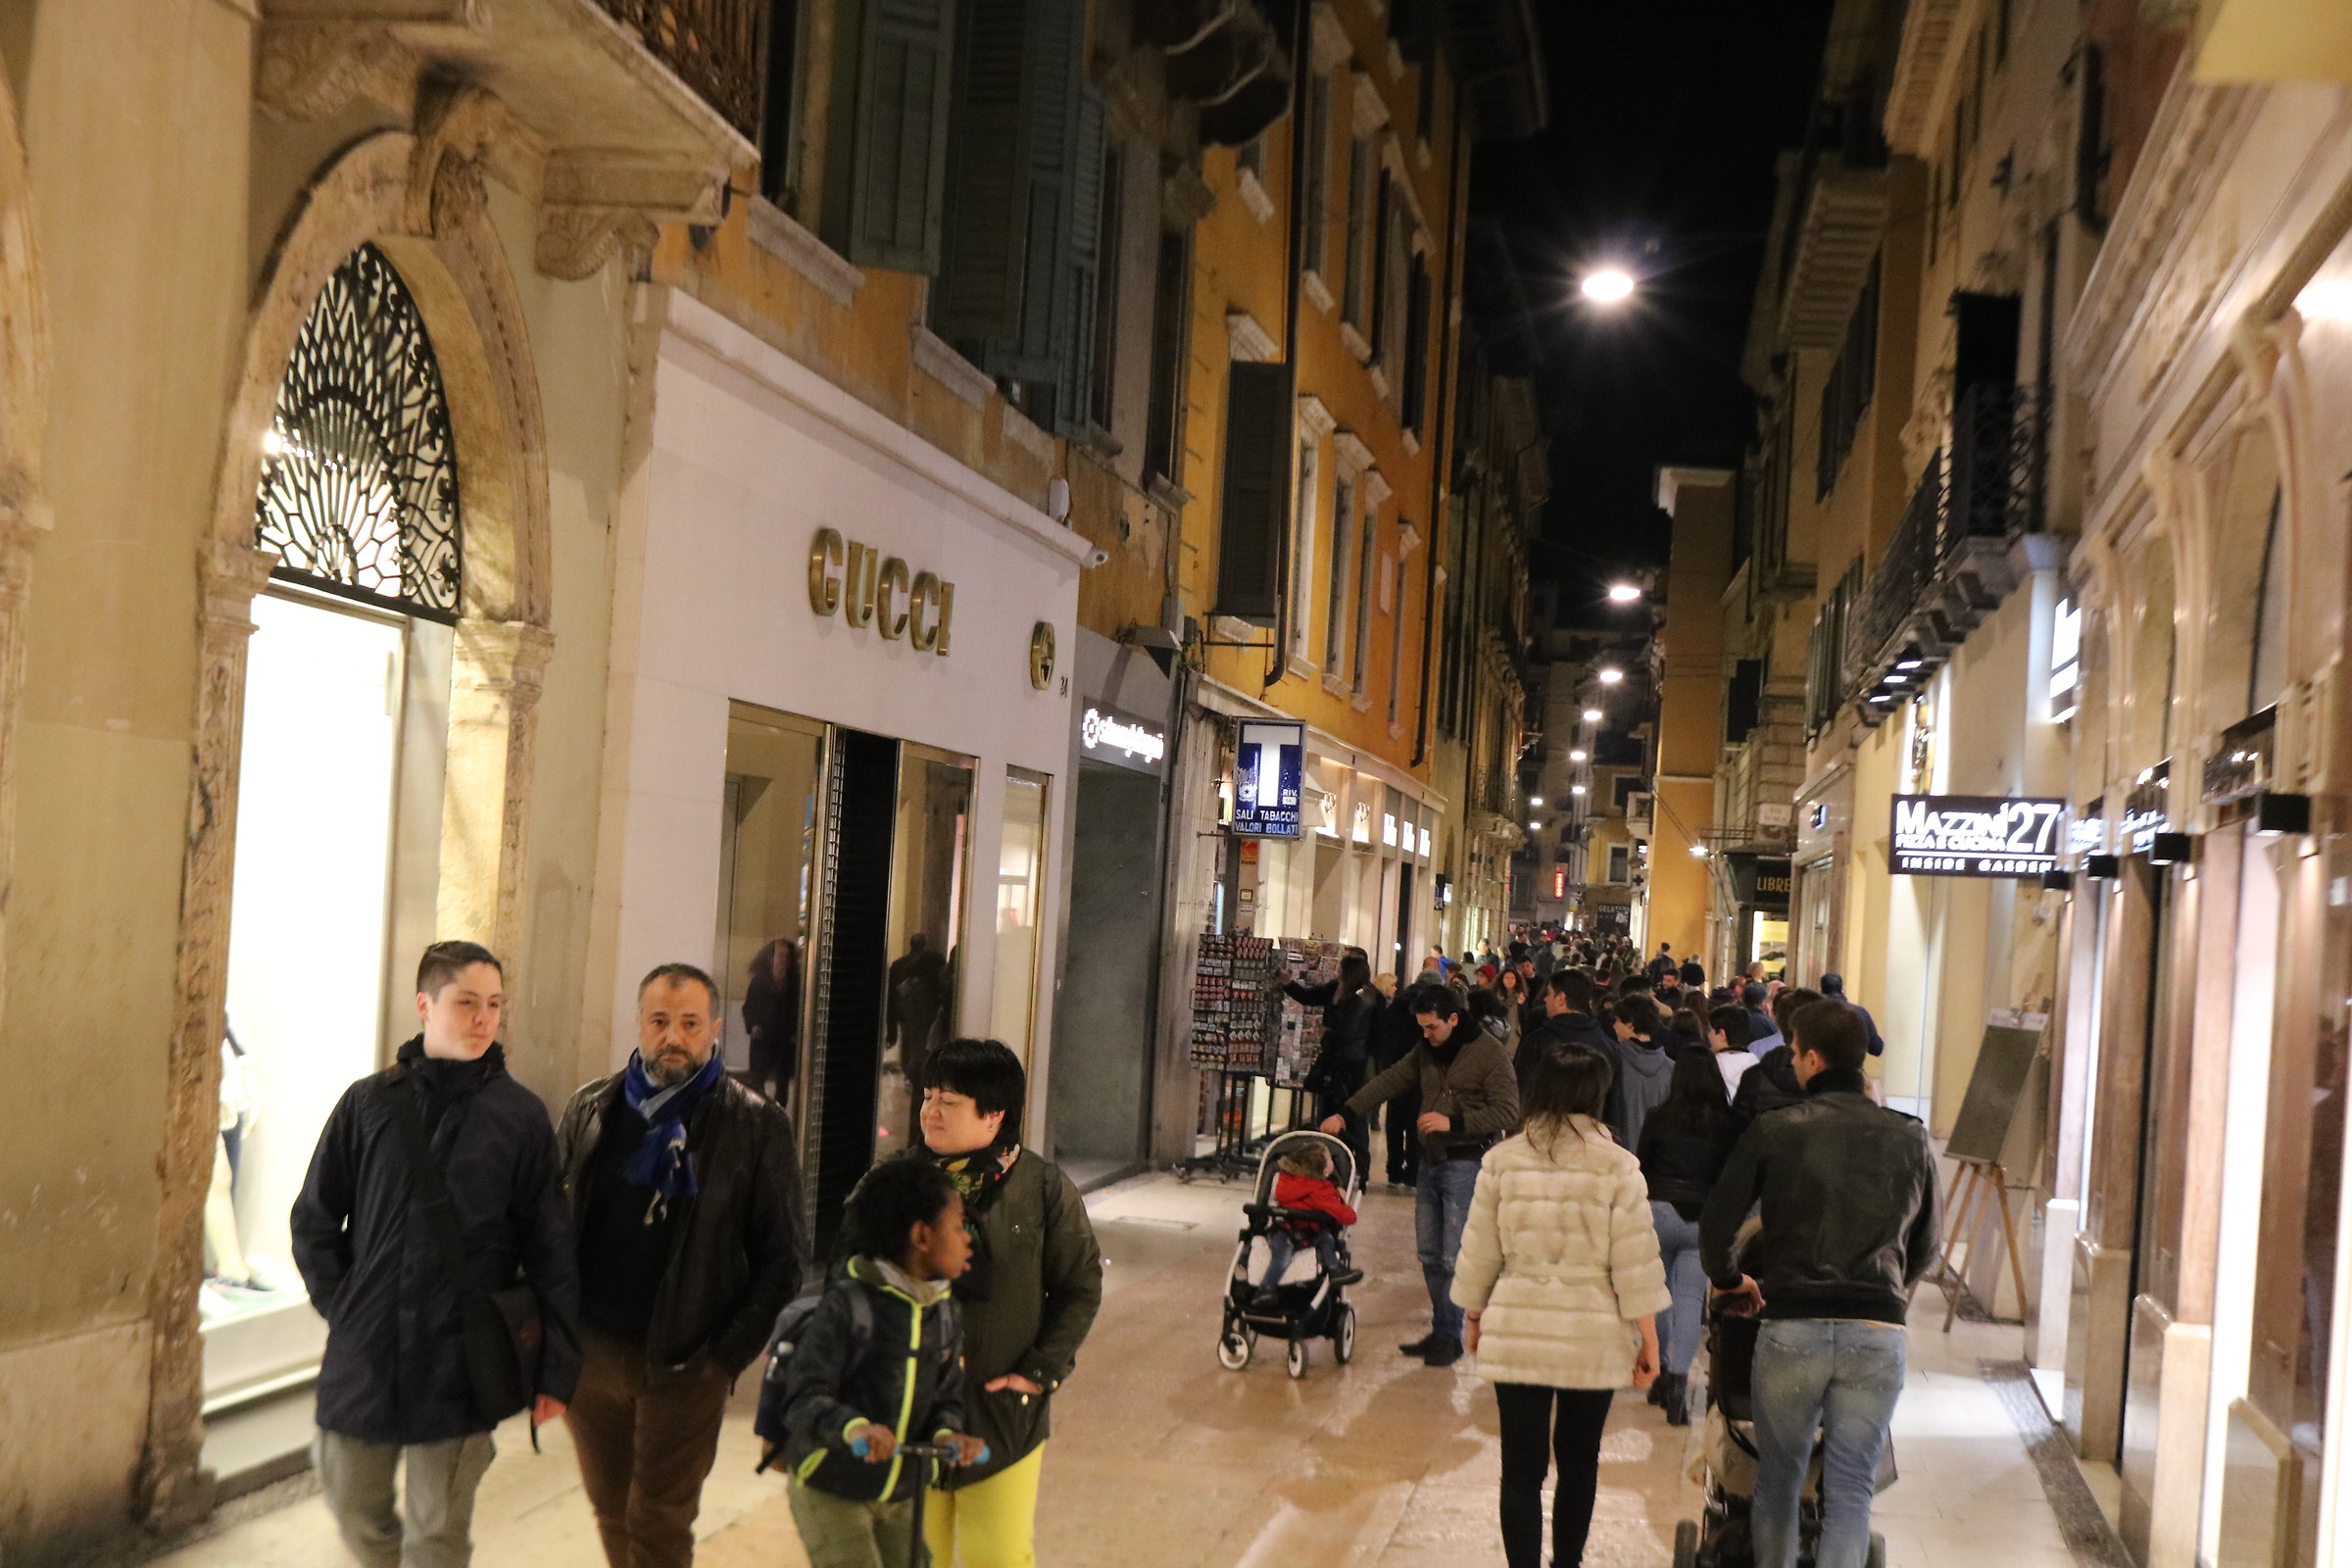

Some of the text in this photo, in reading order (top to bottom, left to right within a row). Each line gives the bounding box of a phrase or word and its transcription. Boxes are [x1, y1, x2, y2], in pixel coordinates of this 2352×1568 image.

[809, 527, 955, 657] GUCCI
[1244, 725, 1300, 807] T
[1236, 808, 1298, 822] SALI TABACCHI
[1235, 821, 1298, 836] VALORI BOLLATI
[1902, 857, 2053, 872] INSIDE GARDEN
